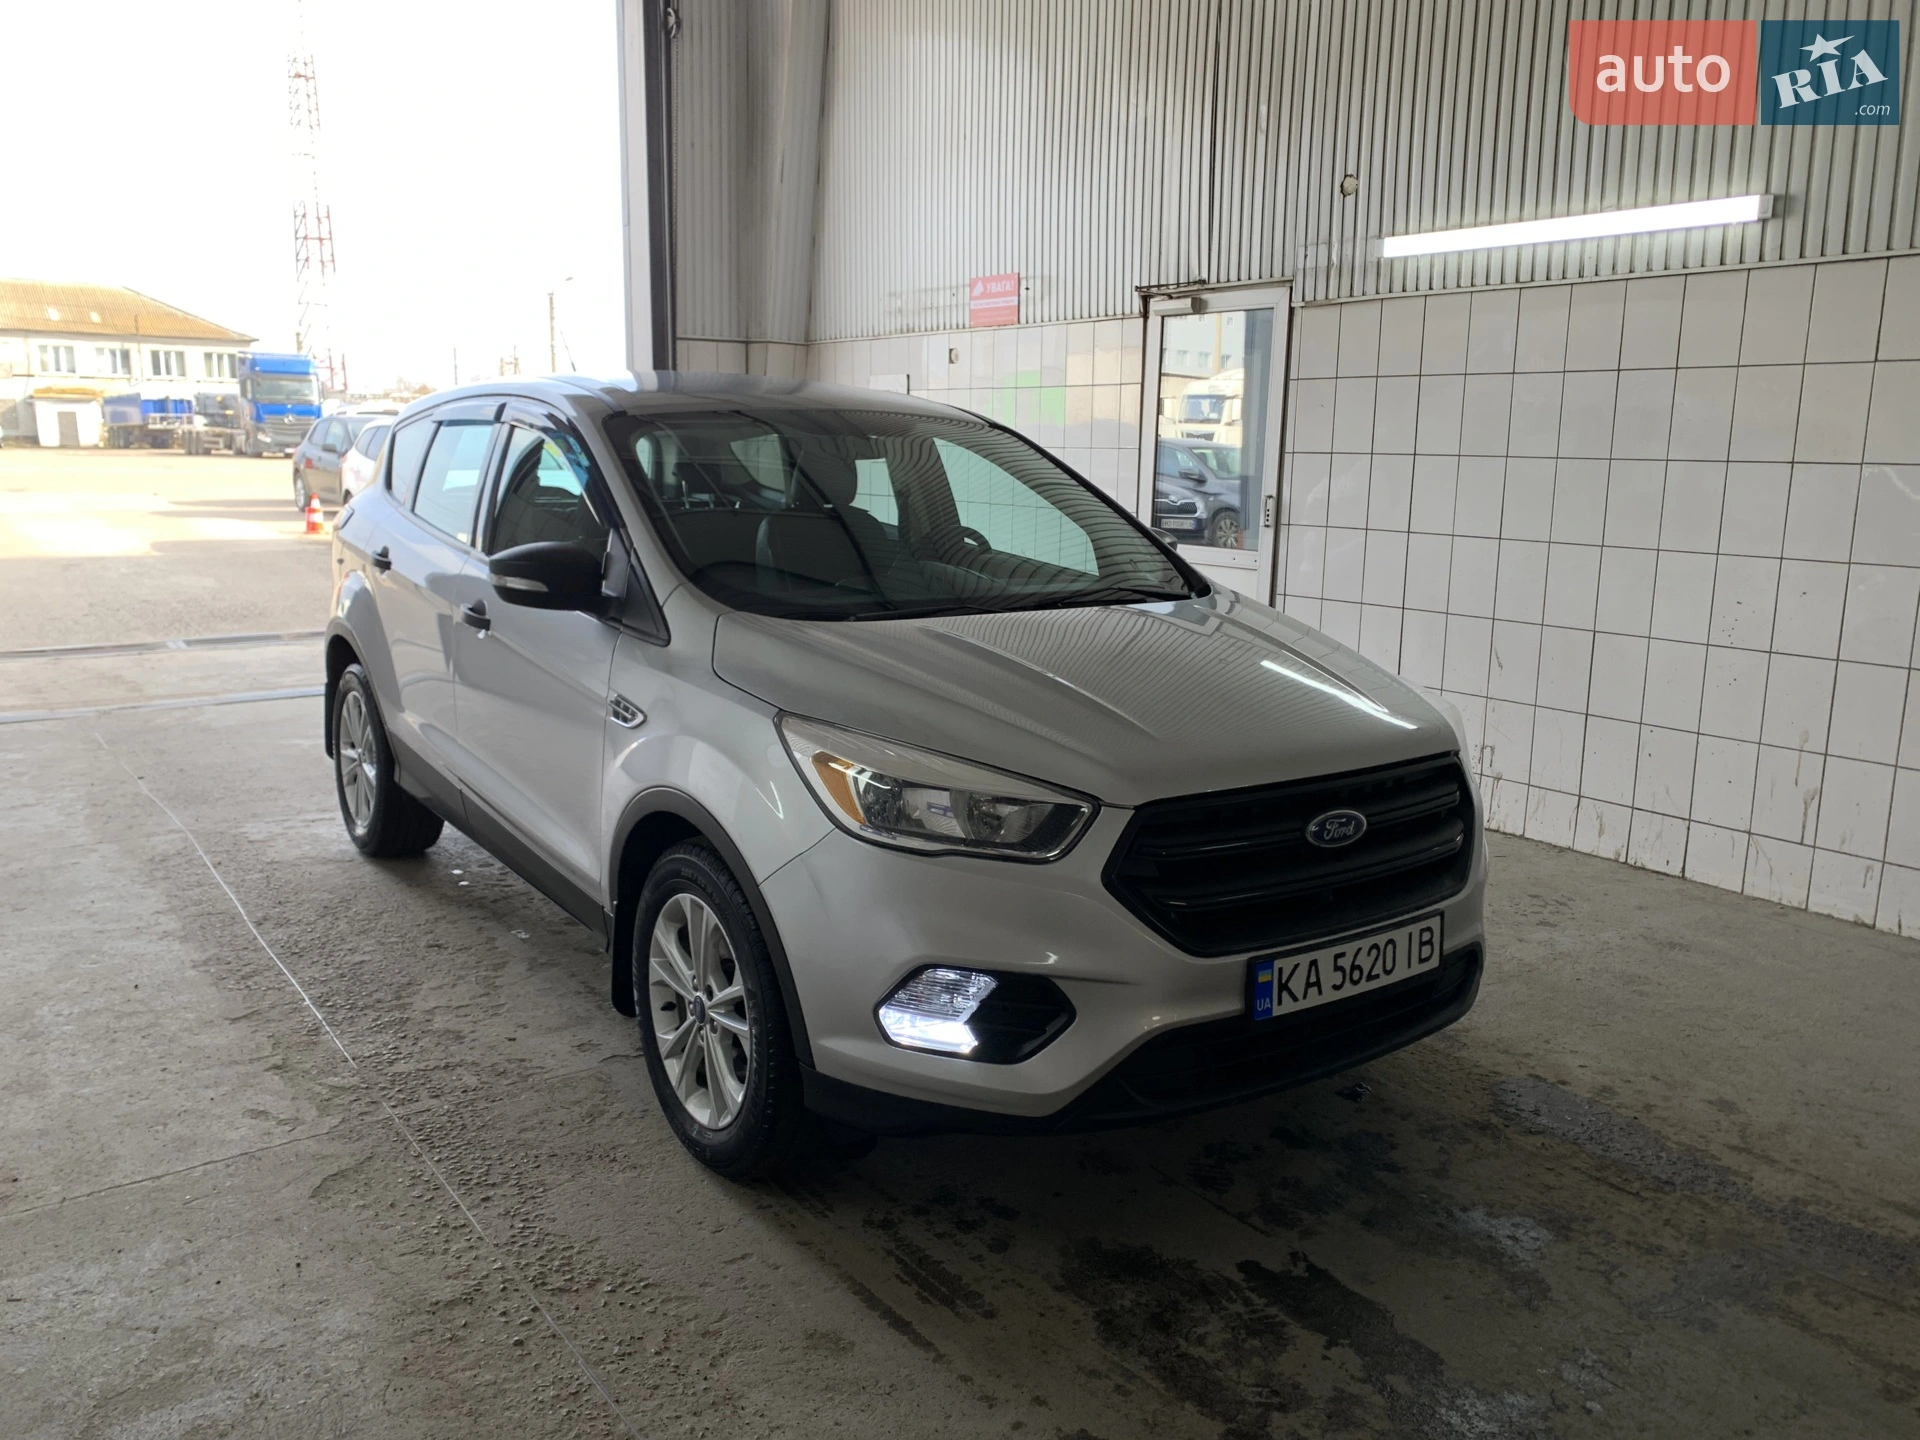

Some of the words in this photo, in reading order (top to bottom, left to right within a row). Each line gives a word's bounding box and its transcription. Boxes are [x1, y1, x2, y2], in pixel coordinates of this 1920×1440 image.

[986, 280, 1015, 293] УВАГА!
[1323, 818, 1355, 840] Ford
[1276, 958, 1323, 1007] KA
[1331, 938, 1397, 991] 5620
[1407, 926, 1435, 970] IB
[1256, 997, 1272, 1011] UA
